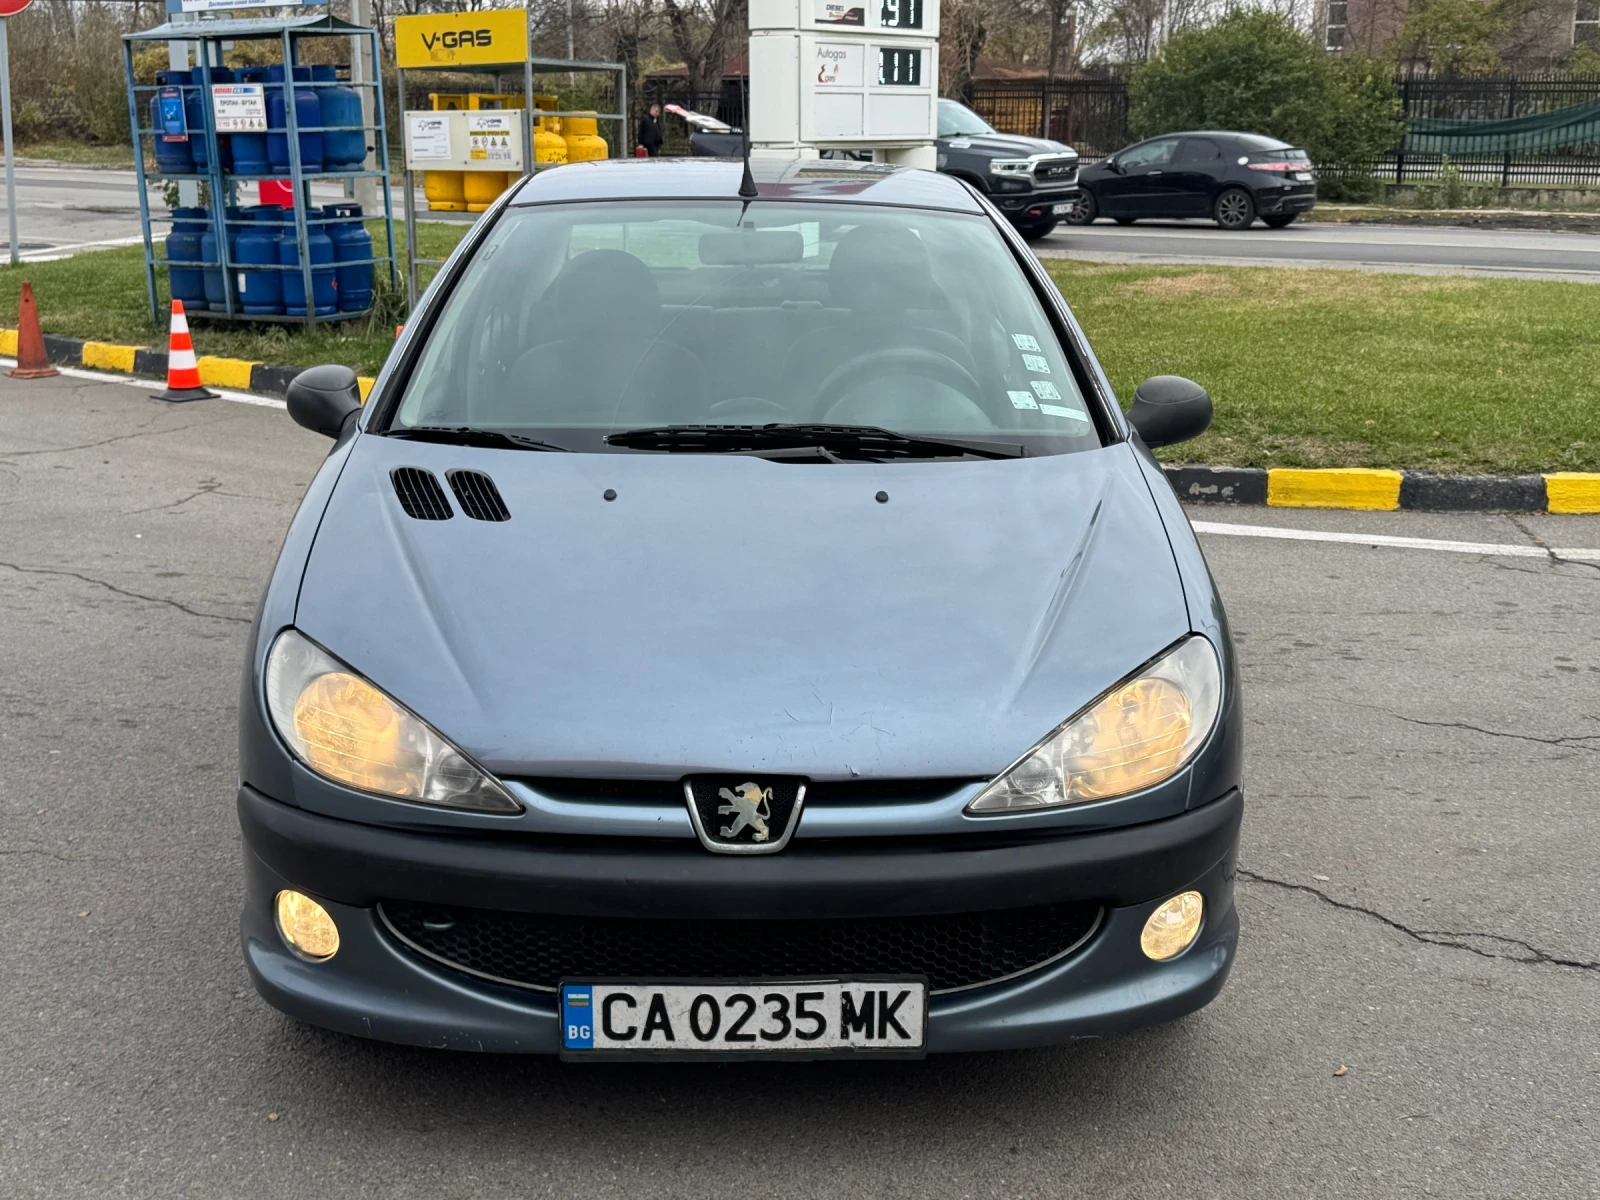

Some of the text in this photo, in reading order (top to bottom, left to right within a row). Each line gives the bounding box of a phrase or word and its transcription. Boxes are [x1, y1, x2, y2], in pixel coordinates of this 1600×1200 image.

[421, 29, 492, 51] V-GAS
[817, 47, 846, 61] Autogas
[602, 990, 912, 1042] CA 0235 MK
[568, 1025, 590, 1039] BG
